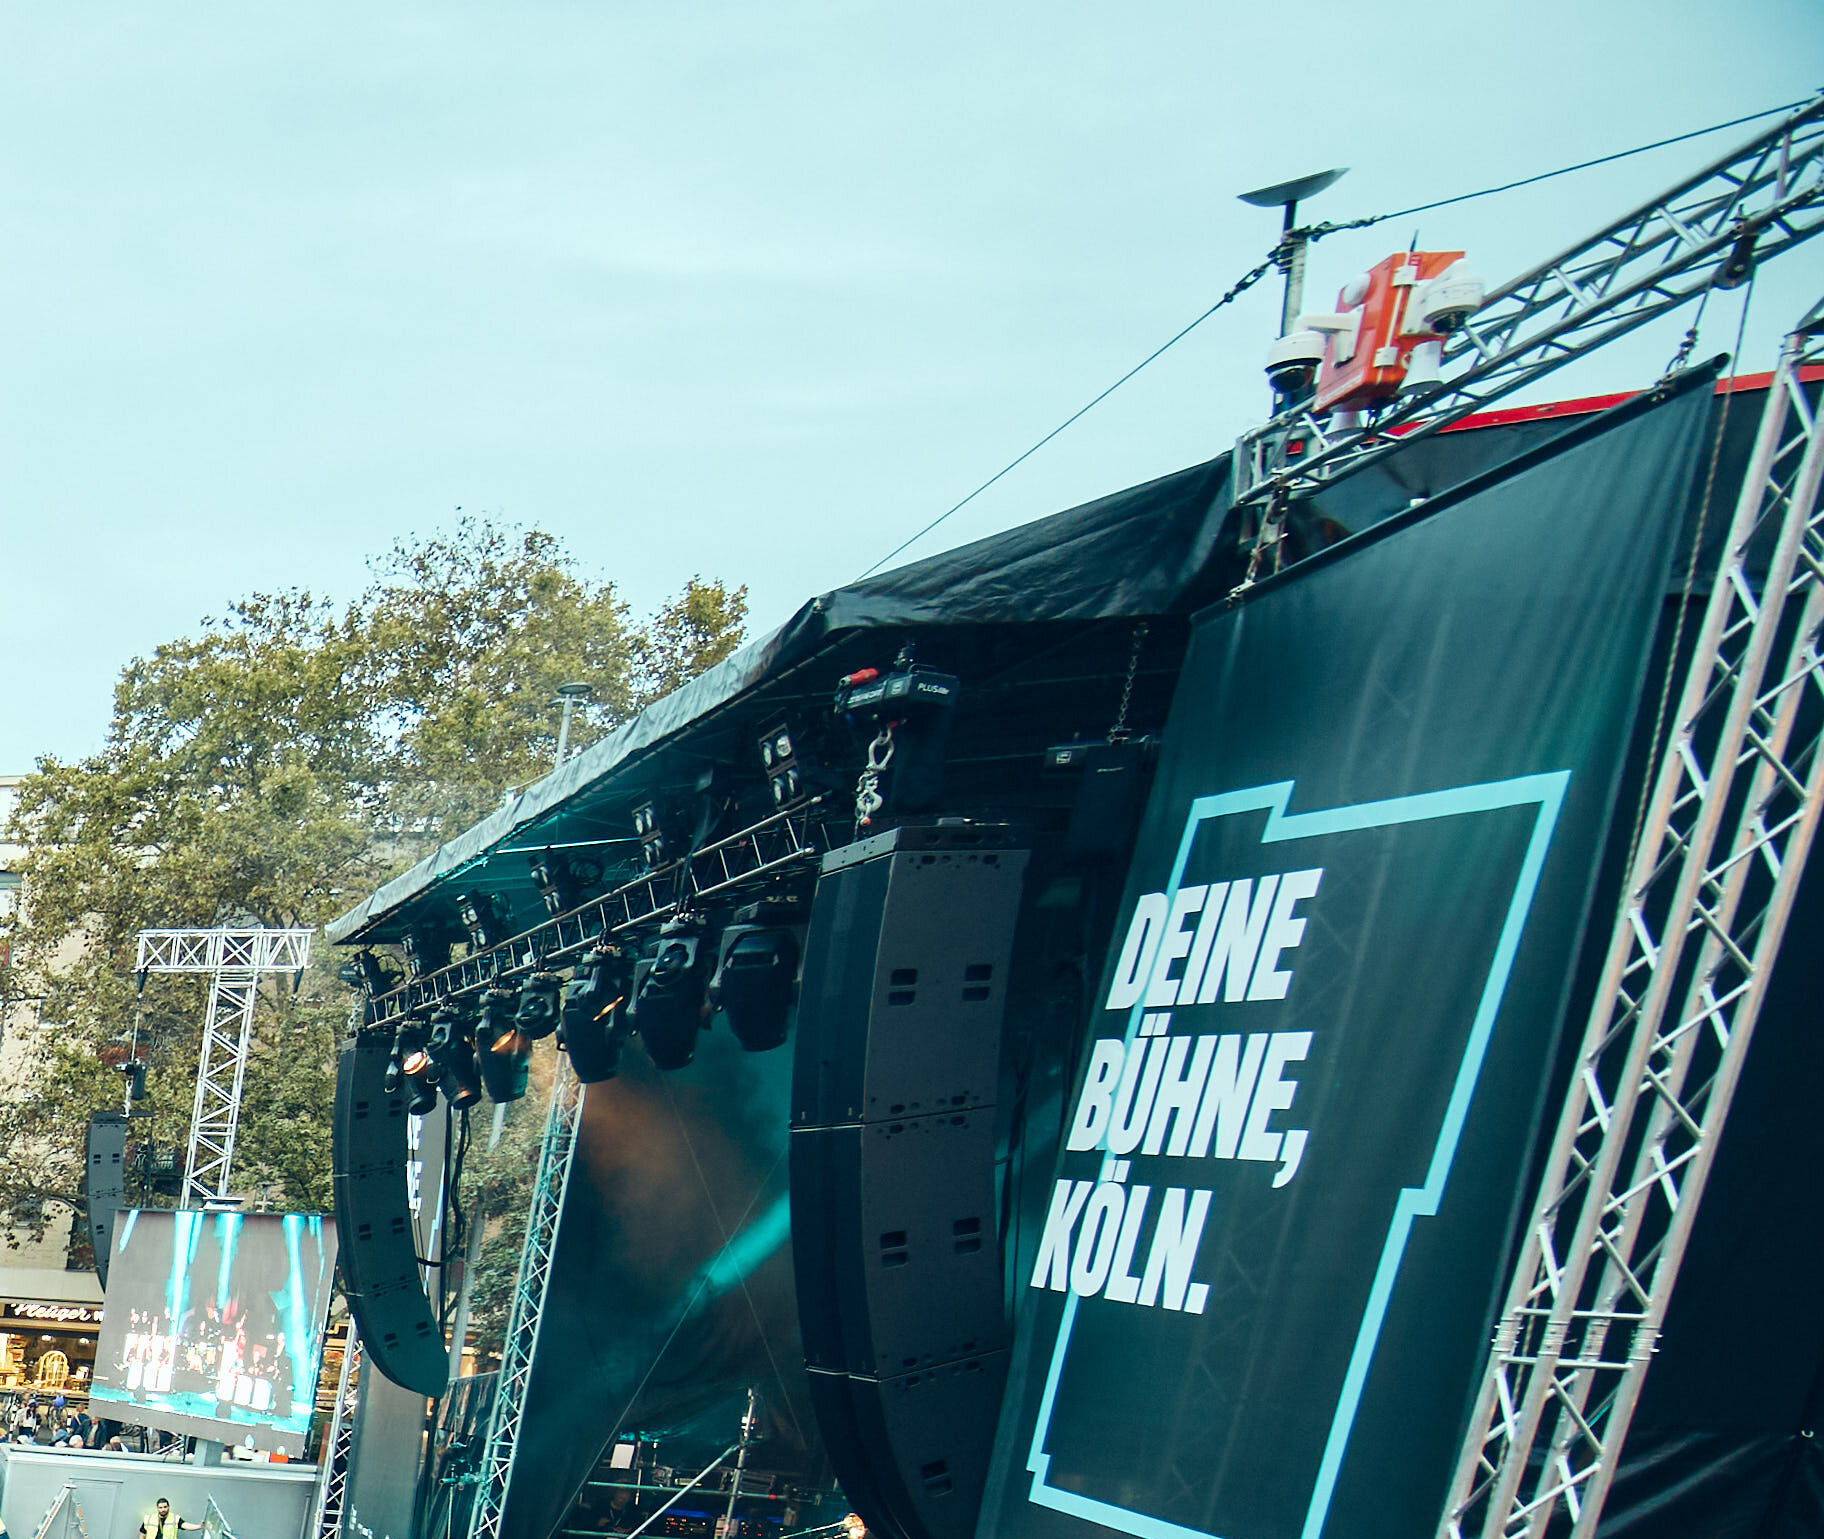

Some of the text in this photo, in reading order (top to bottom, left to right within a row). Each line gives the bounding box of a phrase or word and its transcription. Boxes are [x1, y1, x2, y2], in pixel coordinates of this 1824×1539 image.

[1105, 867, 1324, 1011] DEINE
[1065, 1013, 1313, 1188] BÜHNE,
[1030, 1159, 1216, 1315] KÖLN.
